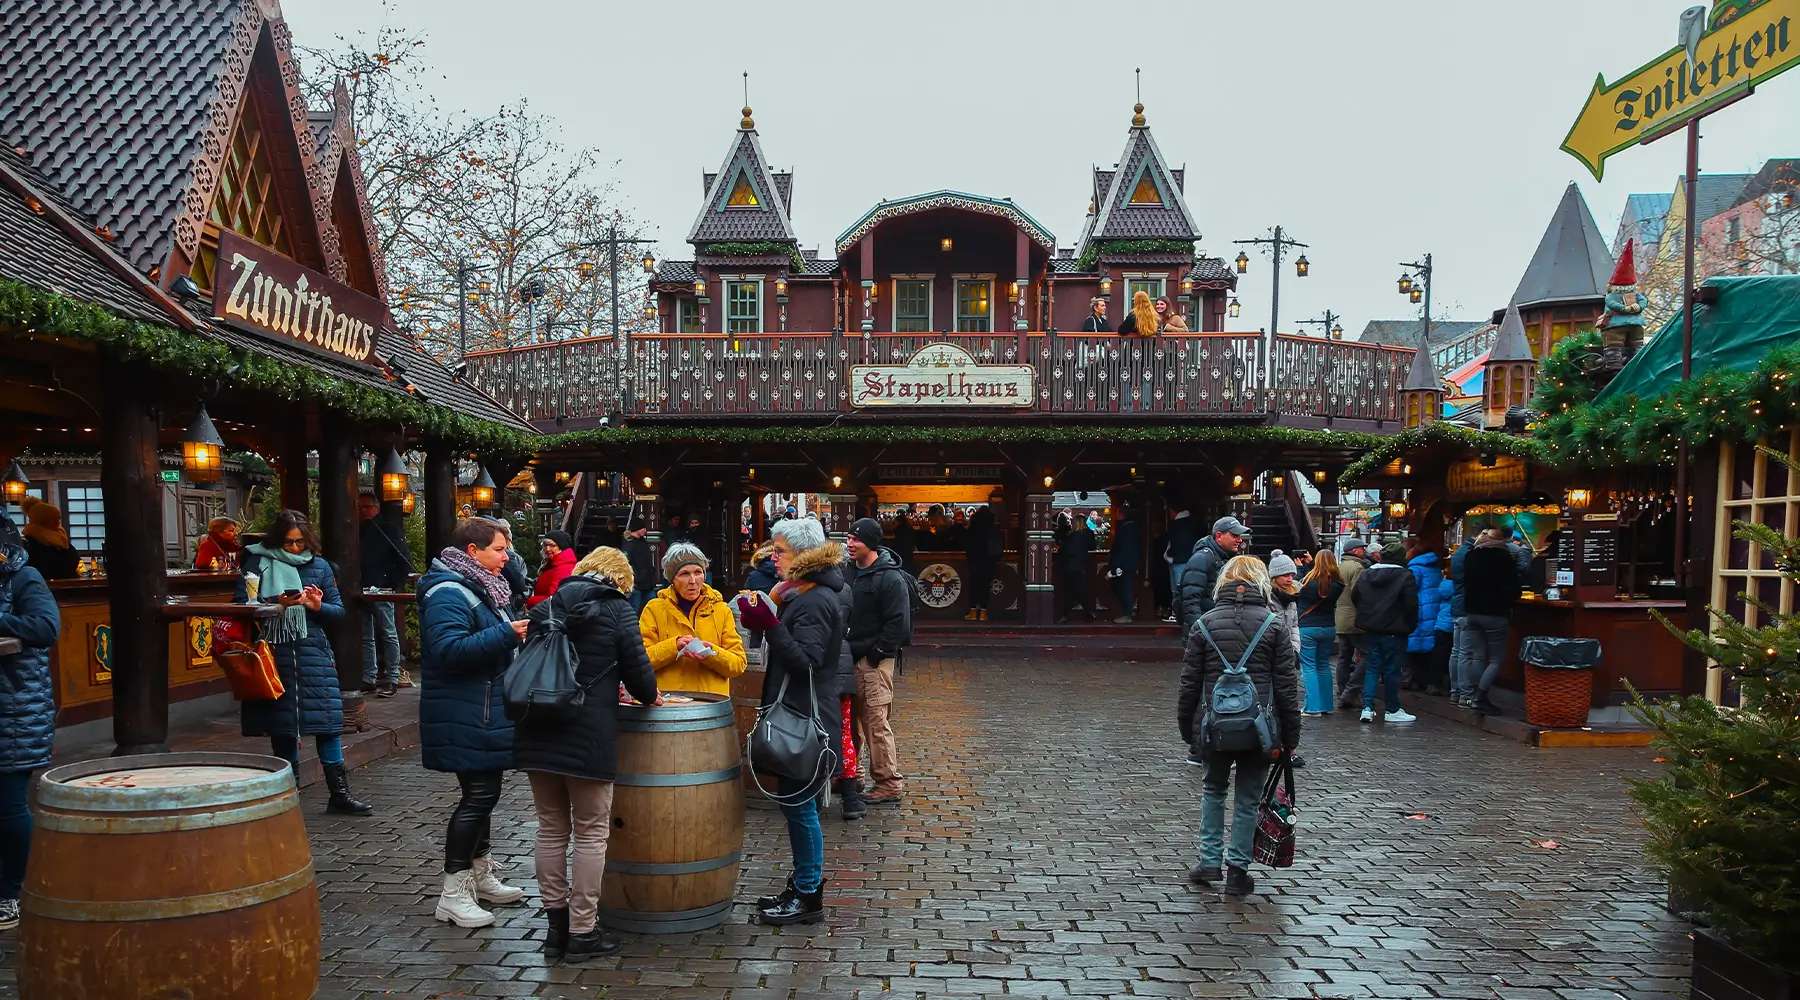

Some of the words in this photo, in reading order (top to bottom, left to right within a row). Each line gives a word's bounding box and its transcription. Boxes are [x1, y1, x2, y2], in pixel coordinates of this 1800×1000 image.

[1612, 16, 1791, 135] Toiletten
[225, 252, 374, 361] Zunfthaus
[859, 372, 1018, 403] Stapelhaus
